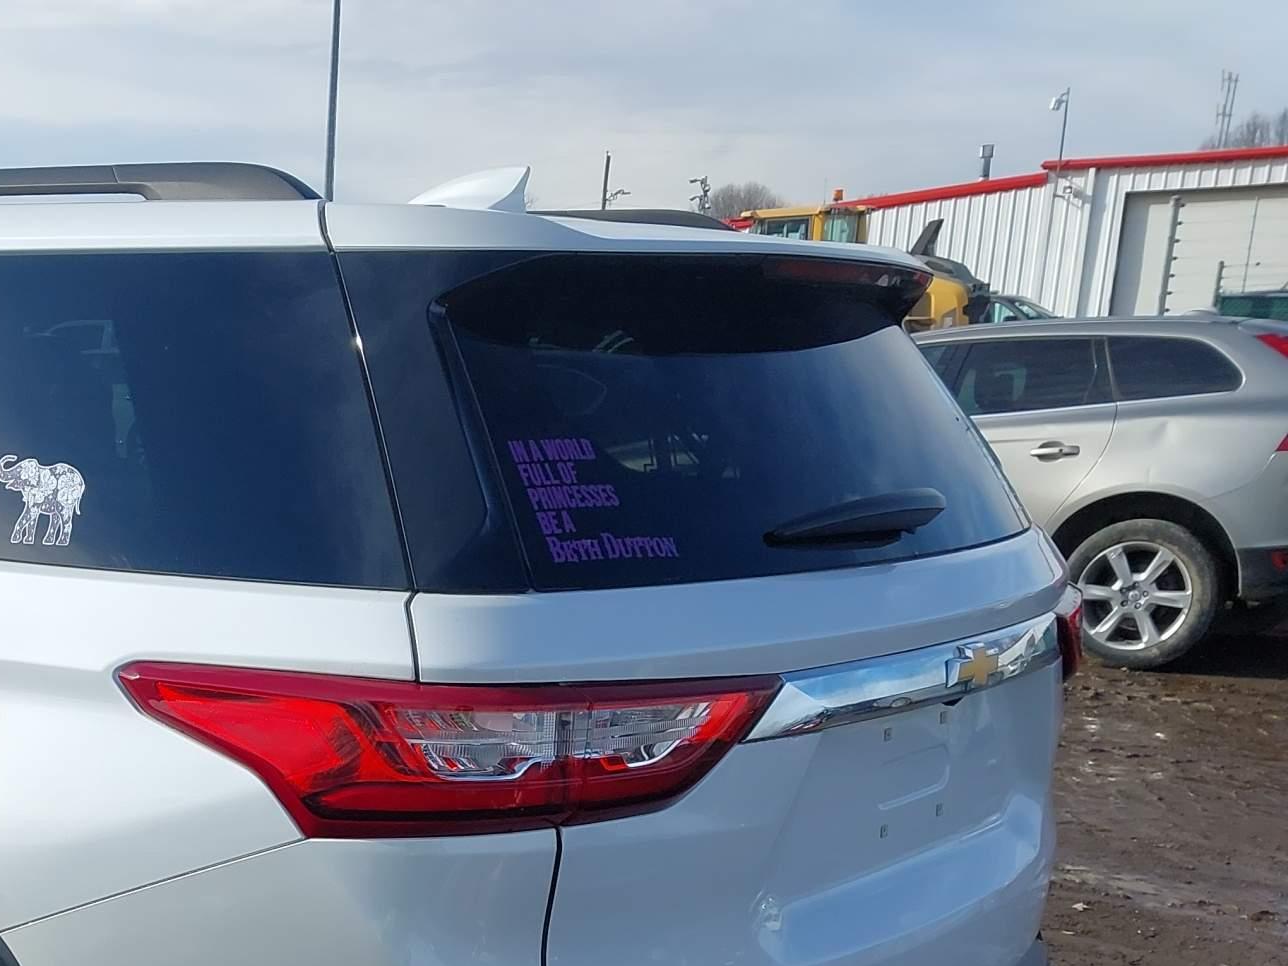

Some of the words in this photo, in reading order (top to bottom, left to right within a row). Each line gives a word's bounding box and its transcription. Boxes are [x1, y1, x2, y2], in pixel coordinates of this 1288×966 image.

[529, 440, 545, 461] A
[541, 439, 596, 461] WORLD
[518, 463, 560, 486] FULL
[558, 462, 577, 484] OF
[527, 484, 620, 510] PRINCESSES
[536, 511, 562, 534] BE
[562, 510, 577, 533] A
